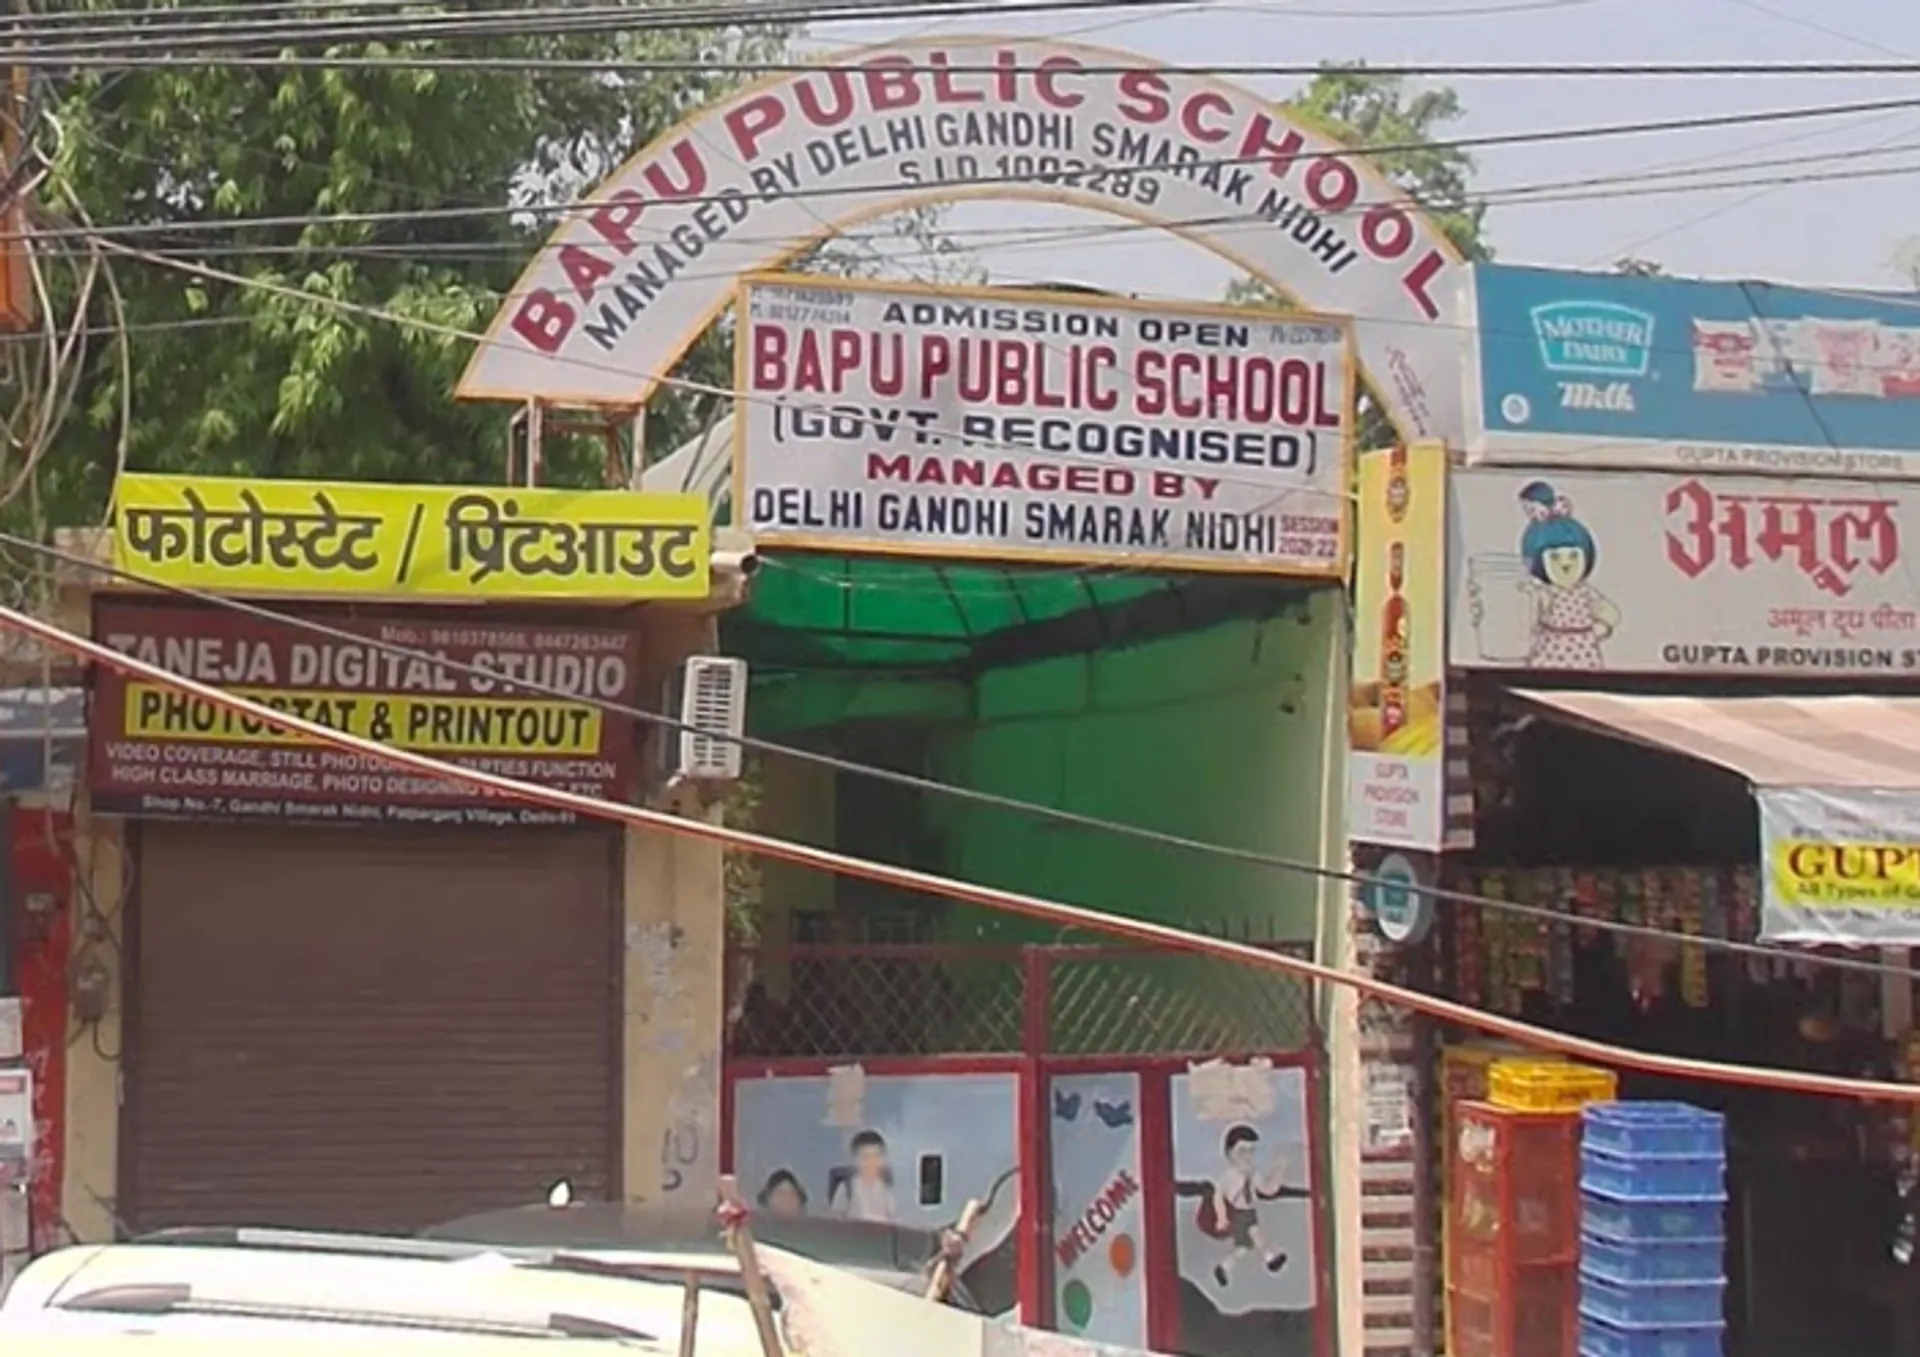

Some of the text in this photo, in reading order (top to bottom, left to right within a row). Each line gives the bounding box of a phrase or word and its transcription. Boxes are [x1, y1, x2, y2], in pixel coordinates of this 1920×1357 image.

[511, 50, 1445, 353] BAPU PUBLIC SCHOOL
[584, 111, 1358, 351] MANAGED BY DELHI GANDHI SMARAK NIDHI
[883, 302, 1119, 338] ADMISSION
[1139, 319, 1249, 348] OPEN
[1541, 315, 1645, 346] MOTHER
[753, 324, 904, 397] BAPU
[921, 334, 1118, 412] PUBLIC
[1135, 349, 1340, 427] SCHOOL
[962, 415, 1317, 475] RECOGNISED)
[1676, 445, 1738, 463] GUPTA
[1742, 448, 1843, 469] PROVISION
[867, 453, 1219, 500] MANAGED BY
[125, 486, 383, 570] फोटोस्टेट
[445, 494, 699, 585] प्रिंटआउट
[753, 487, 1275, 554] DELHI GANDHI SMARAK NIDHI
[1664, 479, 1899, 596] अमूल
[1767, 608, 1826, 636] अमूल
[105, 633, 627, 697] TANEJA DIGITAL STUDIO
[1662, 644, 1750, 665] GUPTA
[1757, 646, 1893, 667] PROVISION
[369, 701, 393, 742] &
[407, 702, 590, 746] PRINTOUT
[106, 742, 160, 762] VIDEO
[270, 750, 317, 769] STILL
[532, 759, 617, 780] FUNCTION
[111, 765, 157, 783] HIGH
[159, 766, 218, 786] CLASS
[322, 774, 383, 793] PHOTO
[1056, 1168, 1140, 1270] WELCOME
